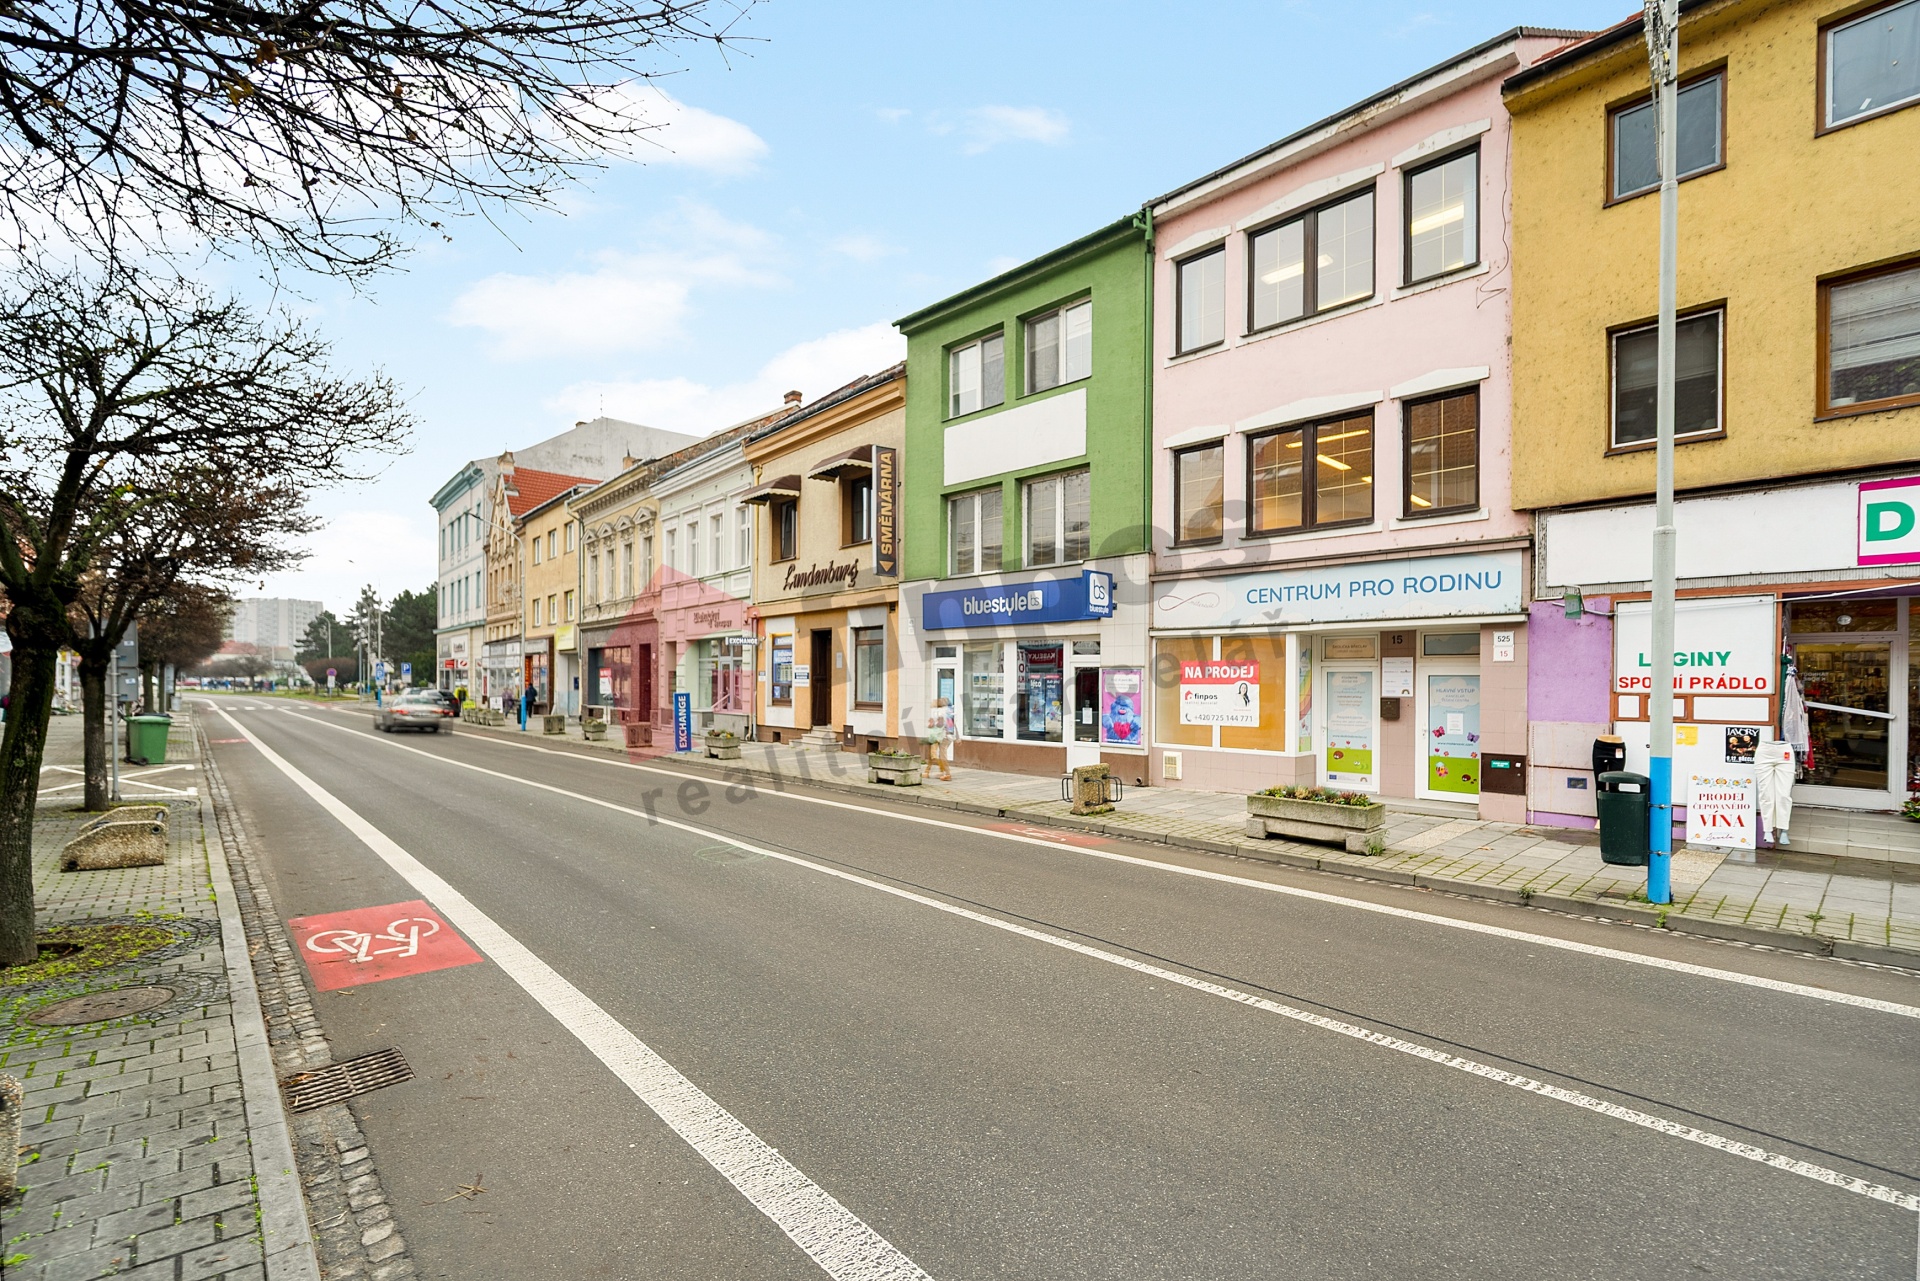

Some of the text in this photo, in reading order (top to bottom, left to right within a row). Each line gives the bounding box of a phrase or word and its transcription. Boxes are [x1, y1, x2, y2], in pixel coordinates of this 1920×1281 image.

[879, 453, 893, 555] SMĚNÁRNA
[1865, 501, 1916, 542] D
[782, 558, 859, 592] Lundenburg
[1246, 571, 1502, 604] CENTRUM PRO RODINU
[963, 592, 1027, 616] bluestyle
[1089, 604, 1109, 615] bluestyle
[729, 637, 758, 645] EXCHANGE
[1391, 635, 1403, 645] 15
[1497, 635, 1511, 643] 525
[1638, 651, 1732, 667] LGINY
[1184, 665, 1254, 679] NA PRODEJ
[1618, 673, 1768, 690] SPOÍ PRÁDLO
[1194, 692, 1218, 701] finpos
[678, 695, 688, 749] EXCHANGE
[1698, 792, 1745, 801] PRODEJ
[1692, 802, 1751, 810] ČEPOVANÉHO
[1699, 810, 1745, 828] VÍNA
